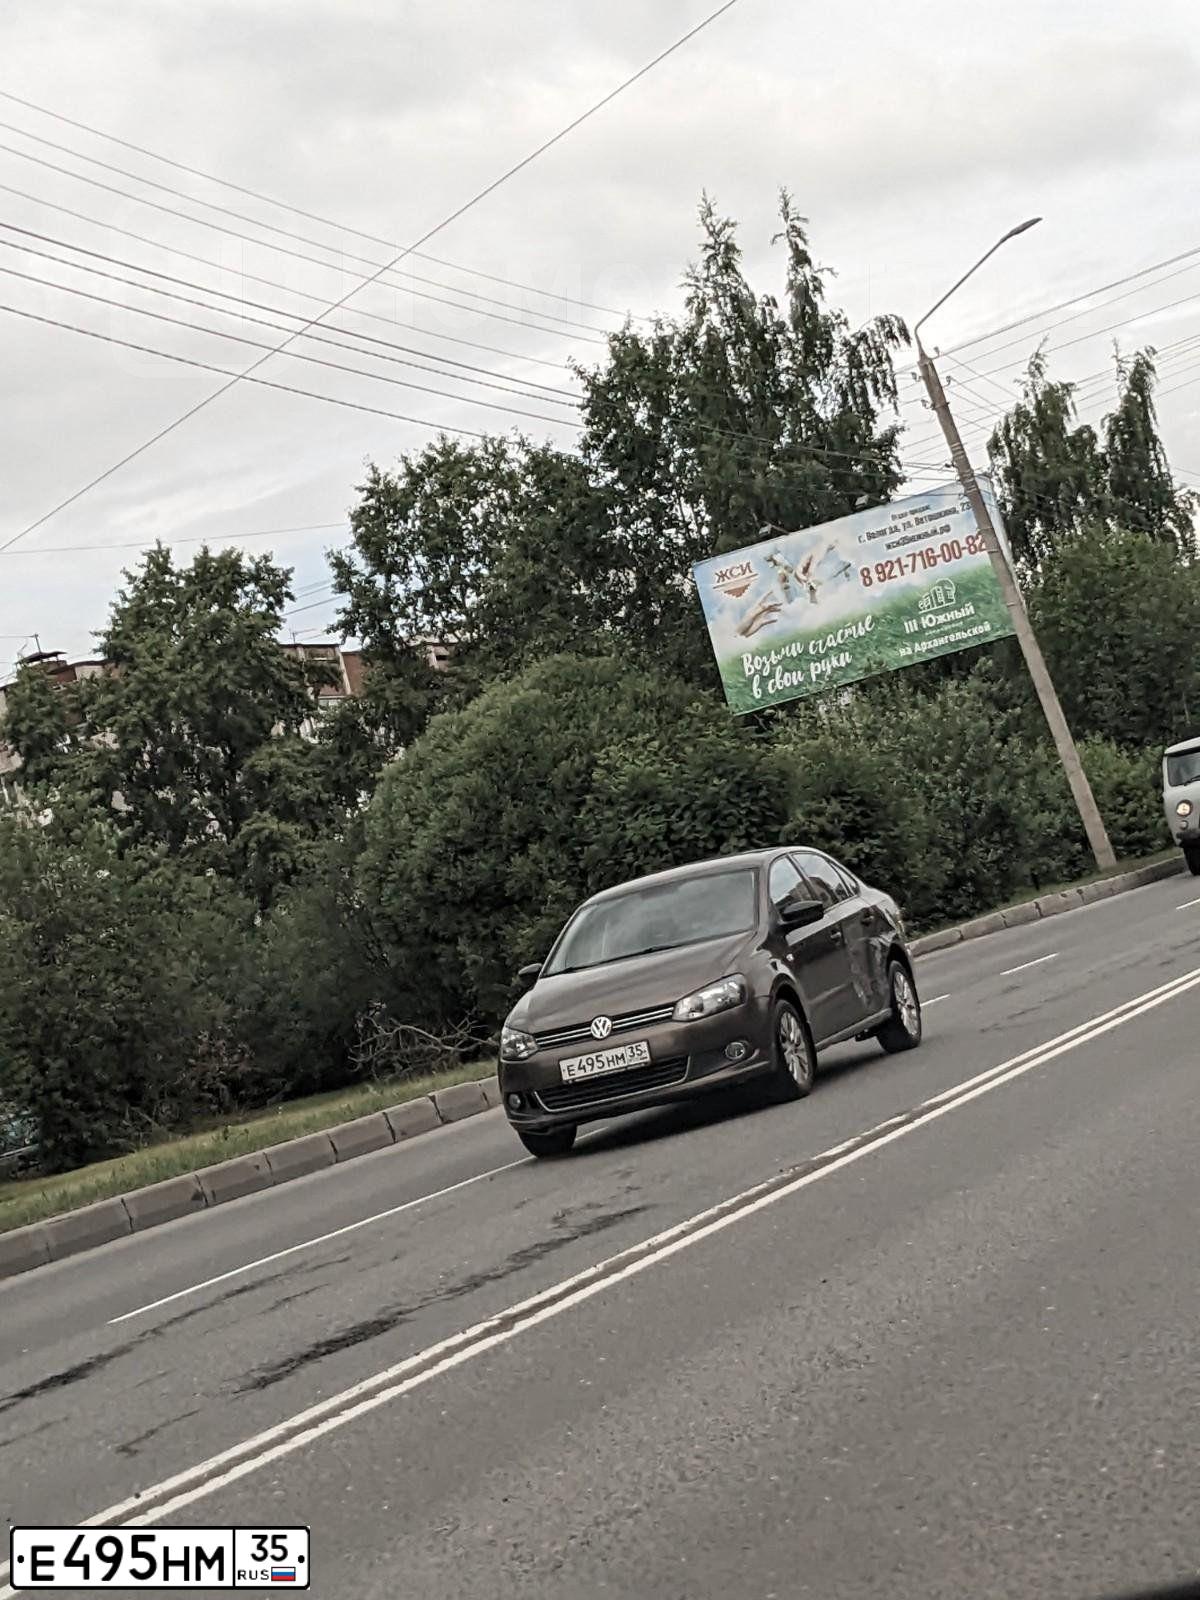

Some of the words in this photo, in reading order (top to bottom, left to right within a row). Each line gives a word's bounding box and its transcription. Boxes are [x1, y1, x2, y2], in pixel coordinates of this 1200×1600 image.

[714, 561, 755, 584] ЖСИ
[859, 566, 874, 588] 8
[874, 532, 987, 583] 921-716-00-82
[921, 601, 976, 629] Южный
[741, 641, 805, 678] Возьми
[808, 614, 876, 654] счастье
[899, 645, 913, 657] на
[914, 620, 992, 653] Архангельской
[752, 674, 763, 700] в
[767, 664, 805, 695] свои
[809, 650, 854, 682] руки
[627, 1044, 645, 1058] 35
